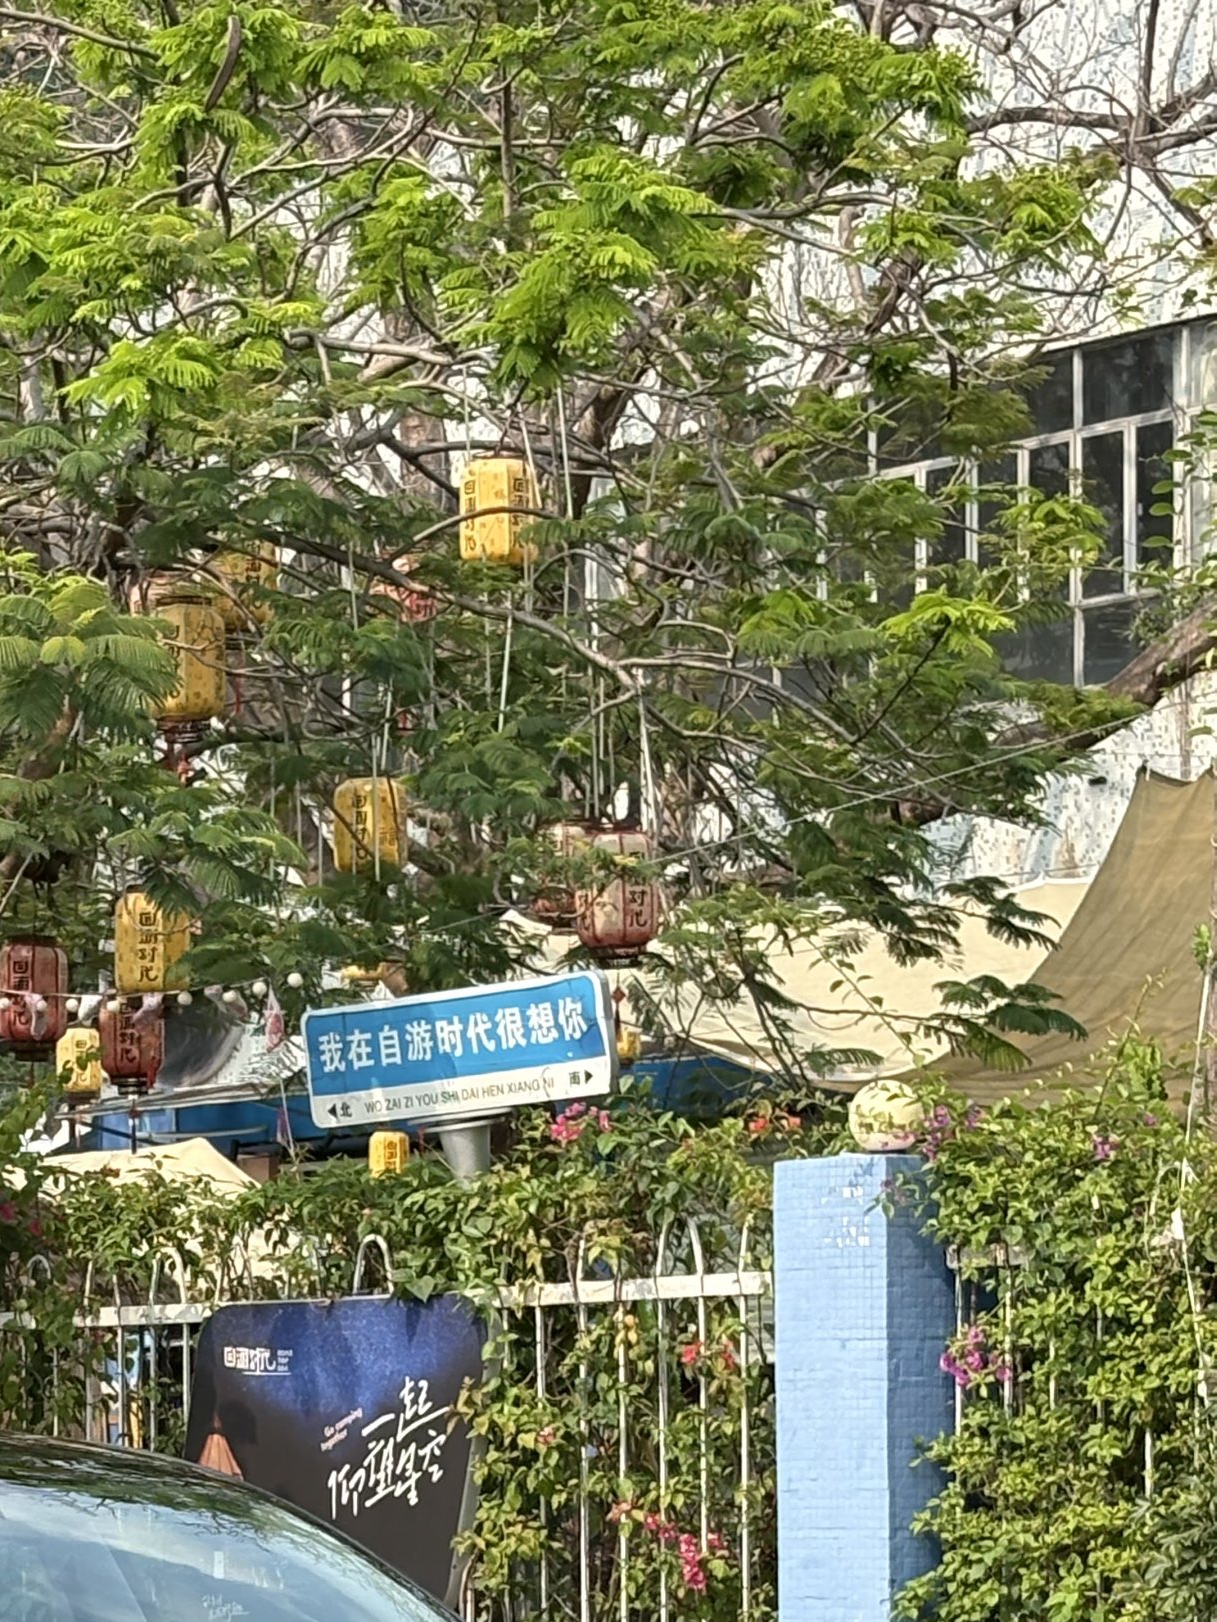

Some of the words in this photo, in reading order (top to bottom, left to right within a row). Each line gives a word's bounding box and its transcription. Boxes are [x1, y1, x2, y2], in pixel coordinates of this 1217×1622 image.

[319, 997, 587, 1073] 我在自游时代很想你
[364, 1100, 383, 1114] WO
[385, 1098, 402, 1111] ZAI
[403, 1096, 414, 1109] ZI
[415, 1092, 439, 1106] YOU
[440, 1090, 460, 1104] SHI
[461, 1087, 480, 1101] DAI
[482, 1083, 505, 1098] HEN
[568, 1071, 581, 1087] 南
[340, 1102, 352, 1117] 北
[361, 1376, 450, 1441] 一起
[328, 1430, 448, 1520] 仰望星空
